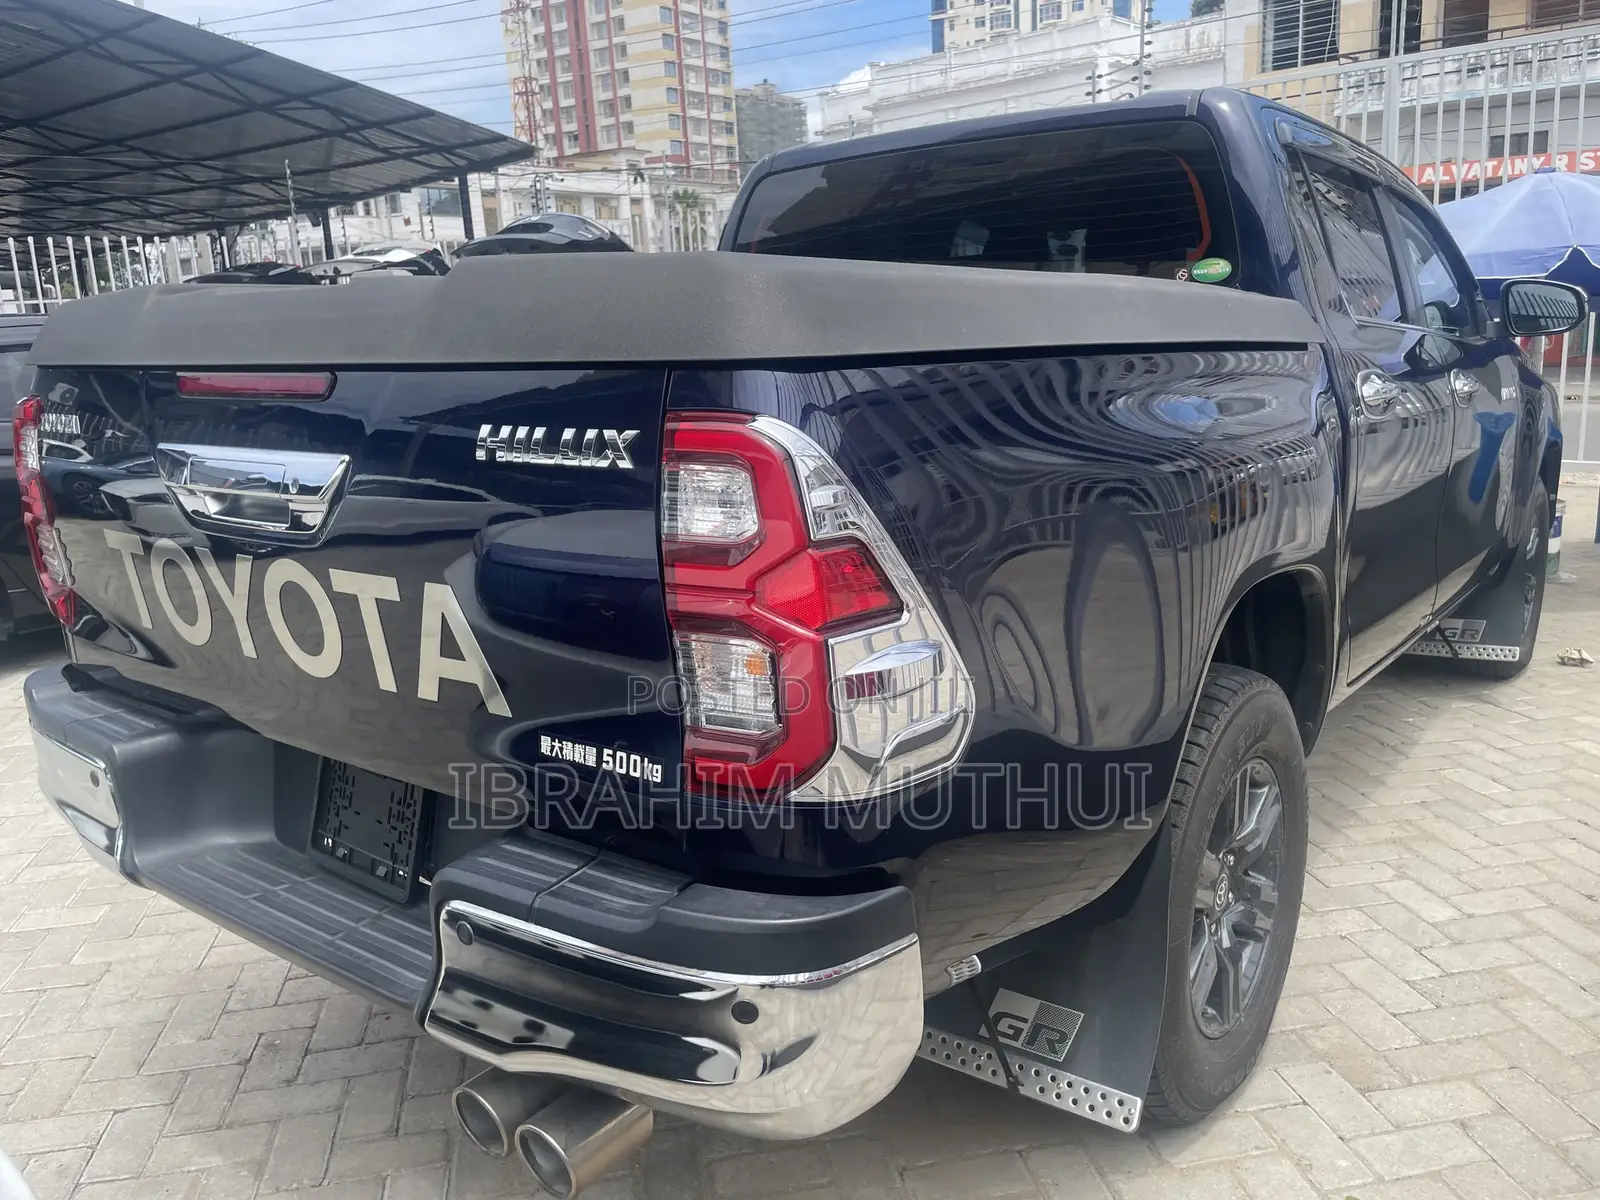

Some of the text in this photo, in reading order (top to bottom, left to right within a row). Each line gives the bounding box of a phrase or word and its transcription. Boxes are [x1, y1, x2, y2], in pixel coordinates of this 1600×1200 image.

[475, 423, 640, 470] HILUX
[103, 528, 512, 718] TOYOTA
[1443, 627, 1480, 640] GR
[540, 735, 663, 783] 最大積載量 500kg
[988, 1011, 1069, 1056] GR
